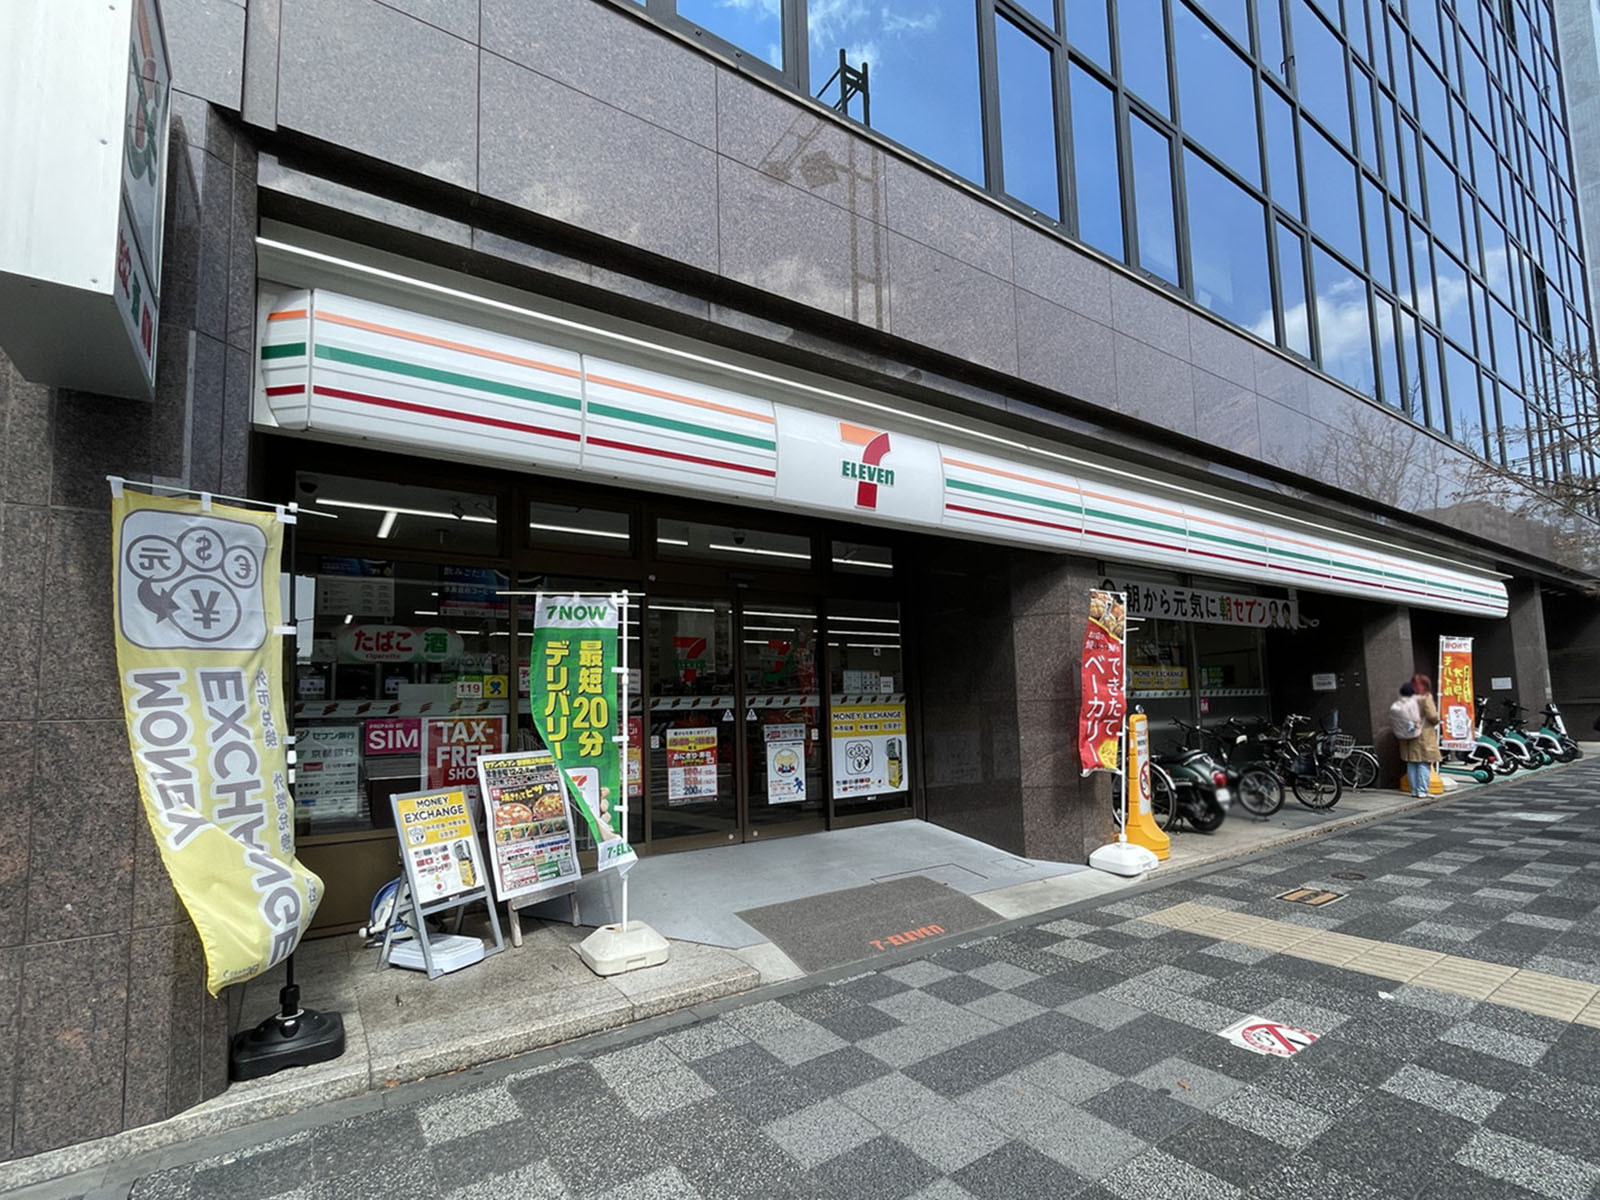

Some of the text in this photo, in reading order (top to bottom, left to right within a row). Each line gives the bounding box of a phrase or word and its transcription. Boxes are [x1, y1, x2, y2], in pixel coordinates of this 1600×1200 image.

[839, 422, 891, 508] 7
[546, 605, 608, 621] 7NOW
[354, 630, 413, 652] たばこ
[424, 632, 448, 654] 酒
[459, 684, 480, 694] 119
[545, 640, 570, 760] デリバリー
[572, 640, 608, 757] 最短20分
[1103, 656, 1122, 736] できたて
[833, 711, 901, 720] MONEY EXCHANGE
[1084, 654, 1106, 763] ベーカリー
[368, 728, 418, 750] SIM
[436, 720, 494, 743] TAX-
[448, 767, 477, 780] SHO
[416, 796, 449, 809] MONEY
[404, 804, 465, 824] EXCHANGE
